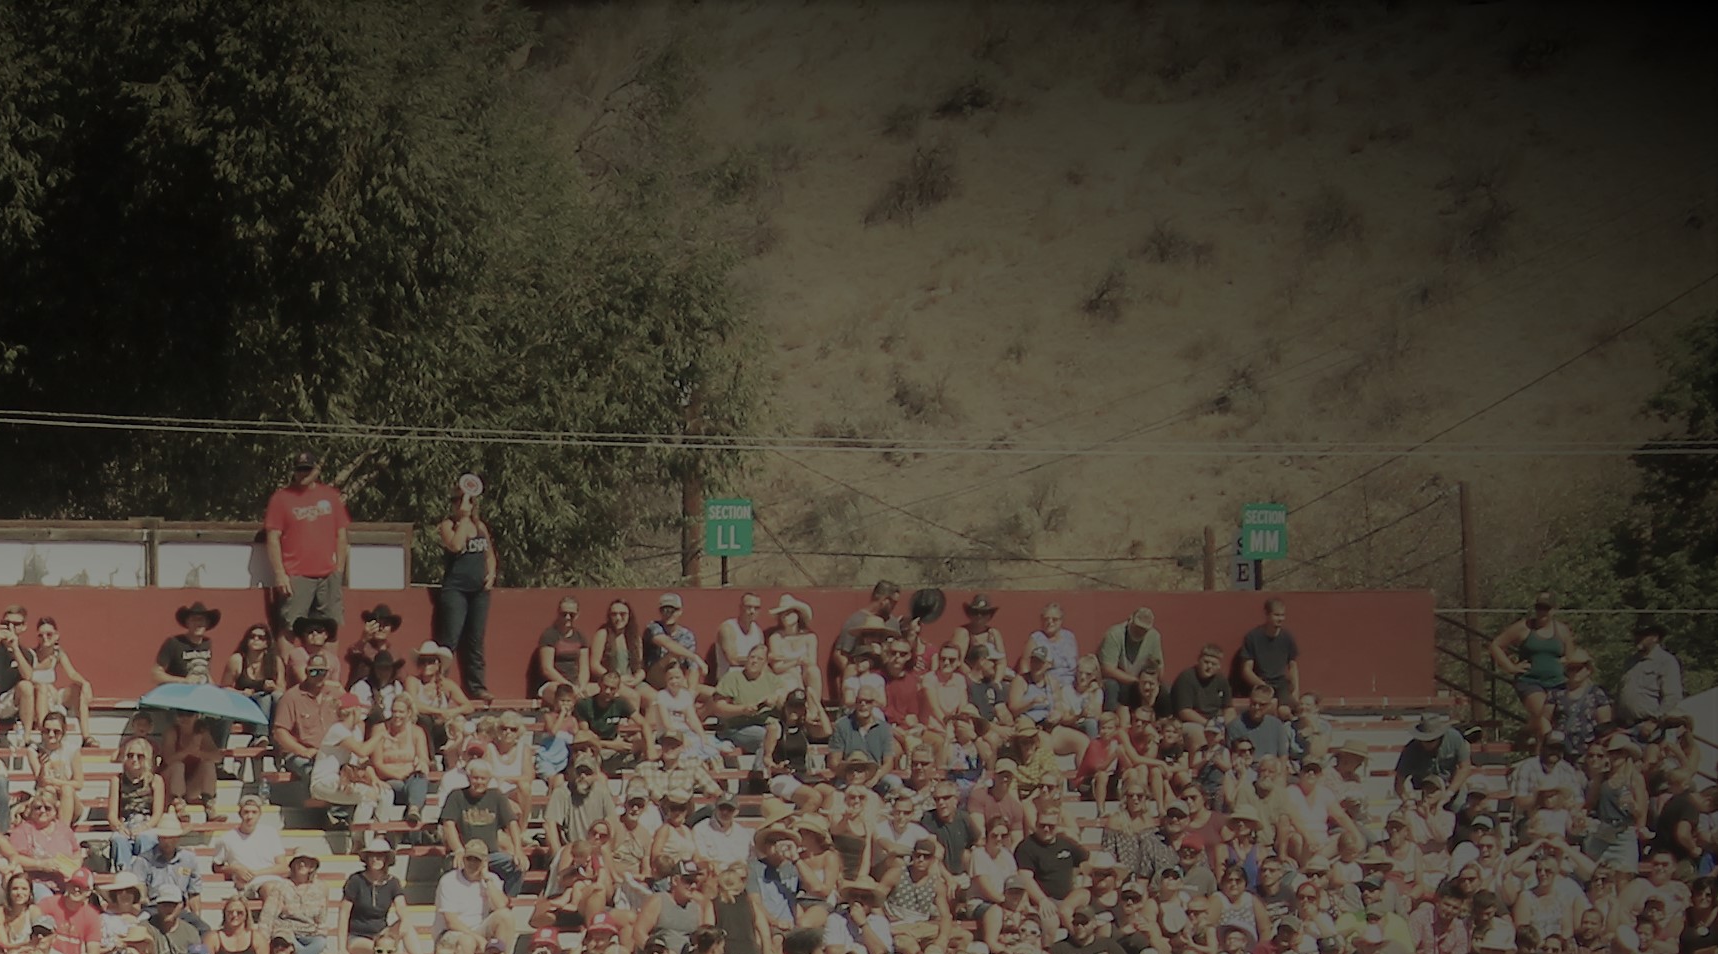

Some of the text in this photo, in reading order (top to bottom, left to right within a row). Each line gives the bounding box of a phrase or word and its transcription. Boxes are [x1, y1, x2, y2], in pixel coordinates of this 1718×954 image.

[708, 505, 752, 520] SECTION
[1245, 510, 1285, 524] SECTION
[717, 525, 741, 549] LL
[1250, 530, 1279, 552] MM
